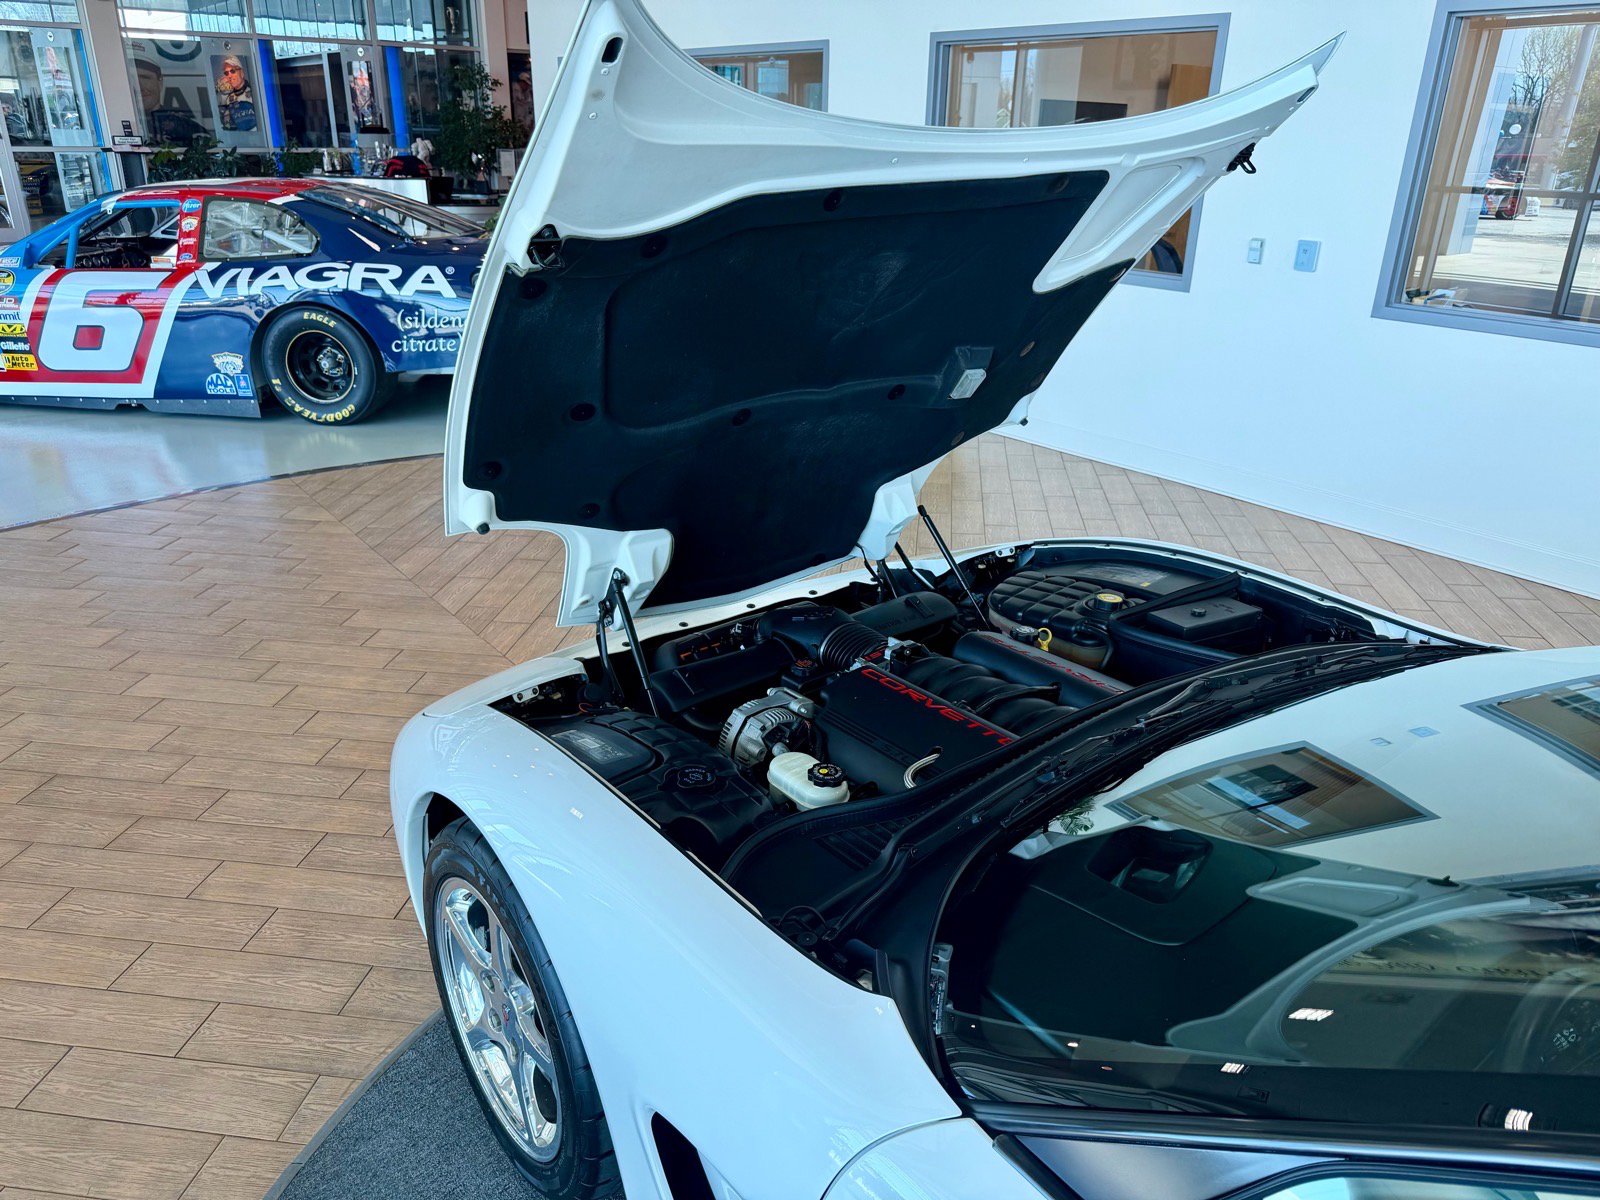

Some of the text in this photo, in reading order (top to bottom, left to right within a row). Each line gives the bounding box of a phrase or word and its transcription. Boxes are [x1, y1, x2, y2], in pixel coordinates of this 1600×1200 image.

[38, 271, 173, 371] 6
[303, 311, 337, 328] EAGLE
[207, 374, 233, 388] MAC
[284, 396, 356, 422] GOODYEAR
